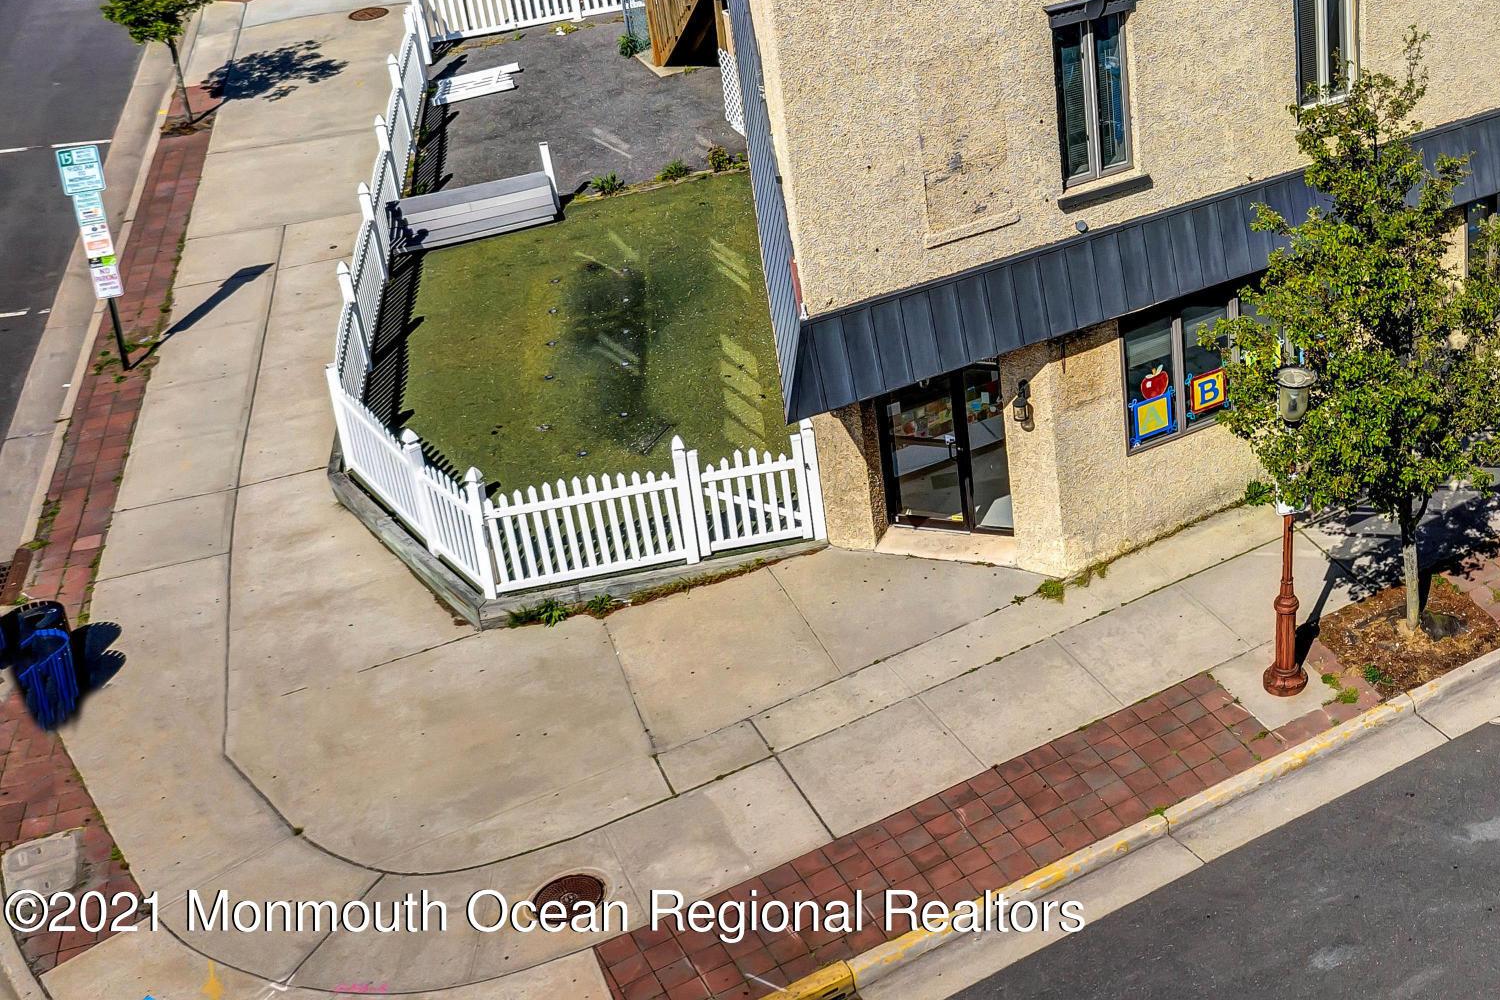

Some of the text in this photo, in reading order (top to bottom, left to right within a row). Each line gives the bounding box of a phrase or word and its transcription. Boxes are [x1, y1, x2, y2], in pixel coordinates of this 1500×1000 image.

[60, 151, 73, 165] 15
[95, 273, 118, 281] PARKING
[1198, 378, 1220, 406] B
[1142, 405, 1164, 431] A
